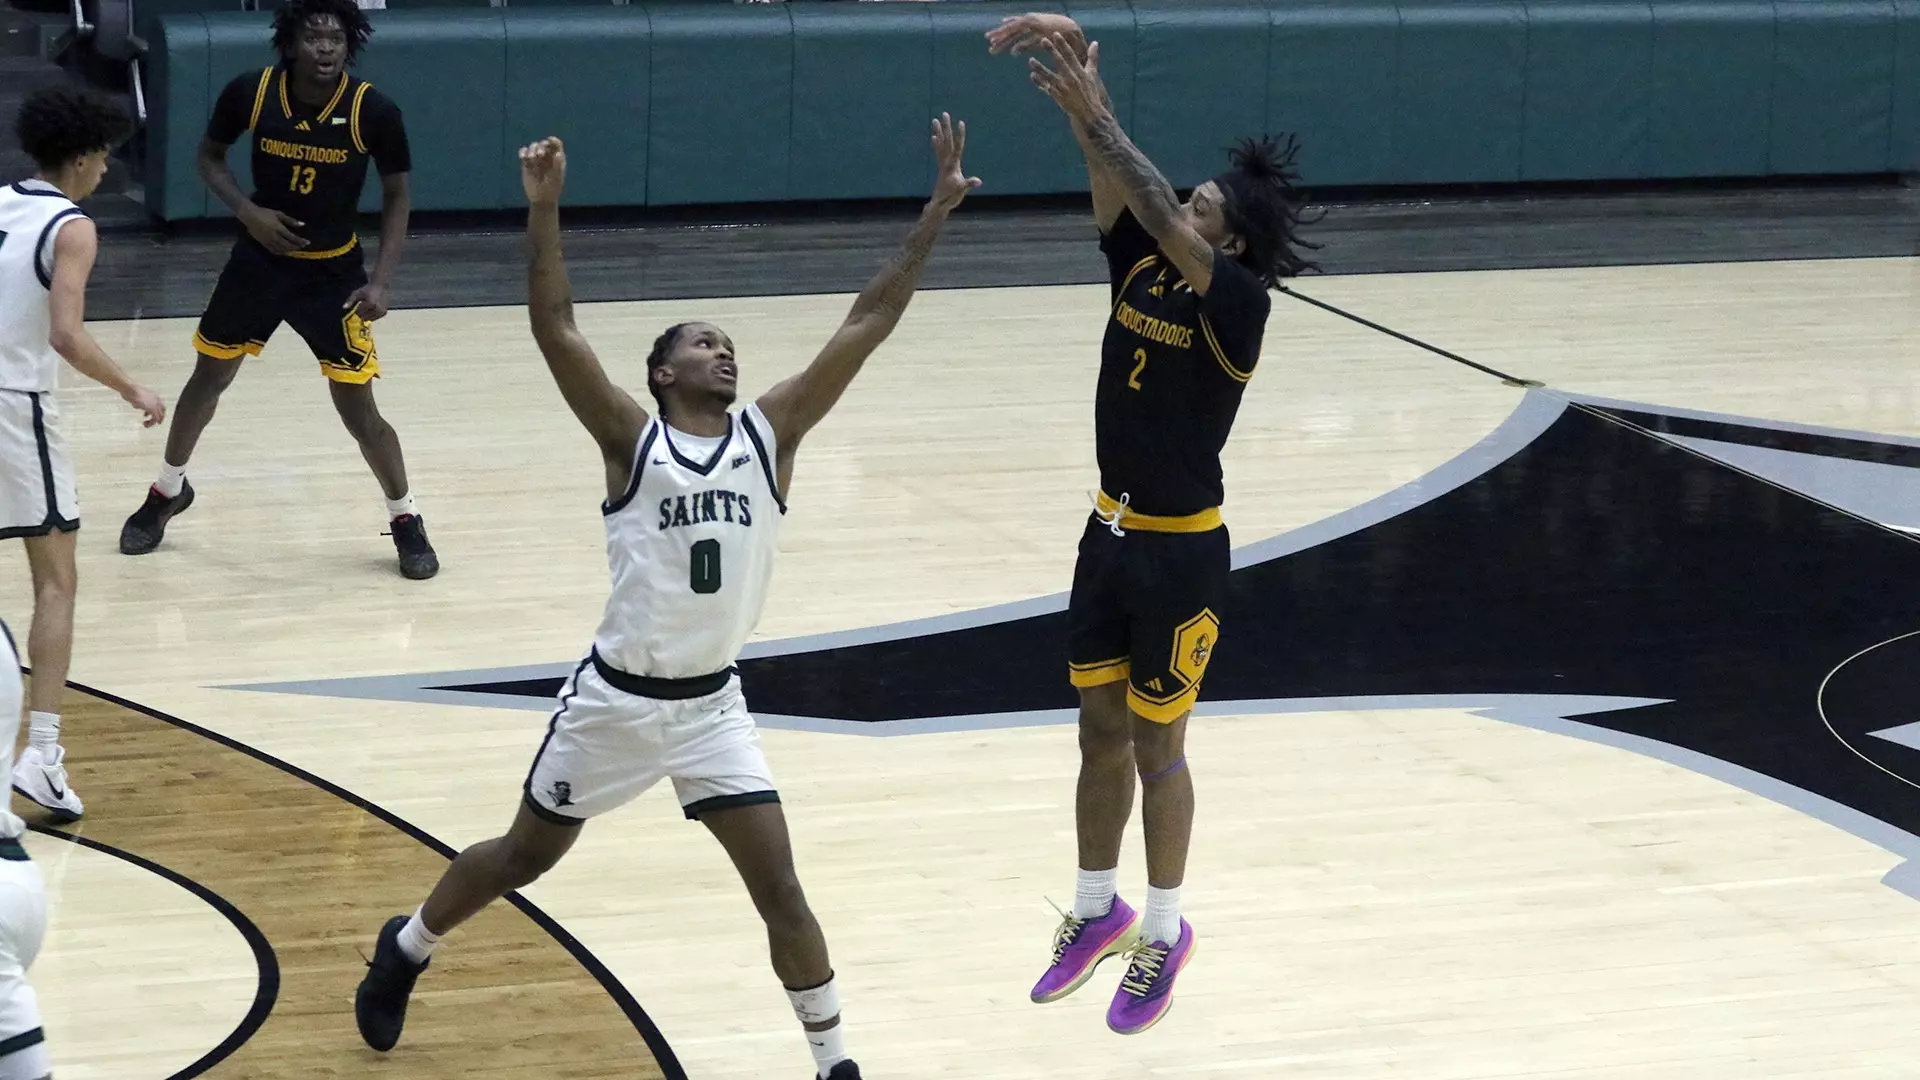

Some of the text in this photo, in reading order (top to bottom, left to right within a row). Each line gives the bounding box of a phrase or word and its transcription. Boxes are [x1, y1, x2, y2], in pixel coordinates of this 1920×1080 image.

[260, 138, 348, 163] CONQUISTADORS
[289, 165, 316, 194] 13
[1128, 348, 1147, 391] 2
[659, 489, 752, 531] SAINTS
[690, 538, 721, 594] 0
